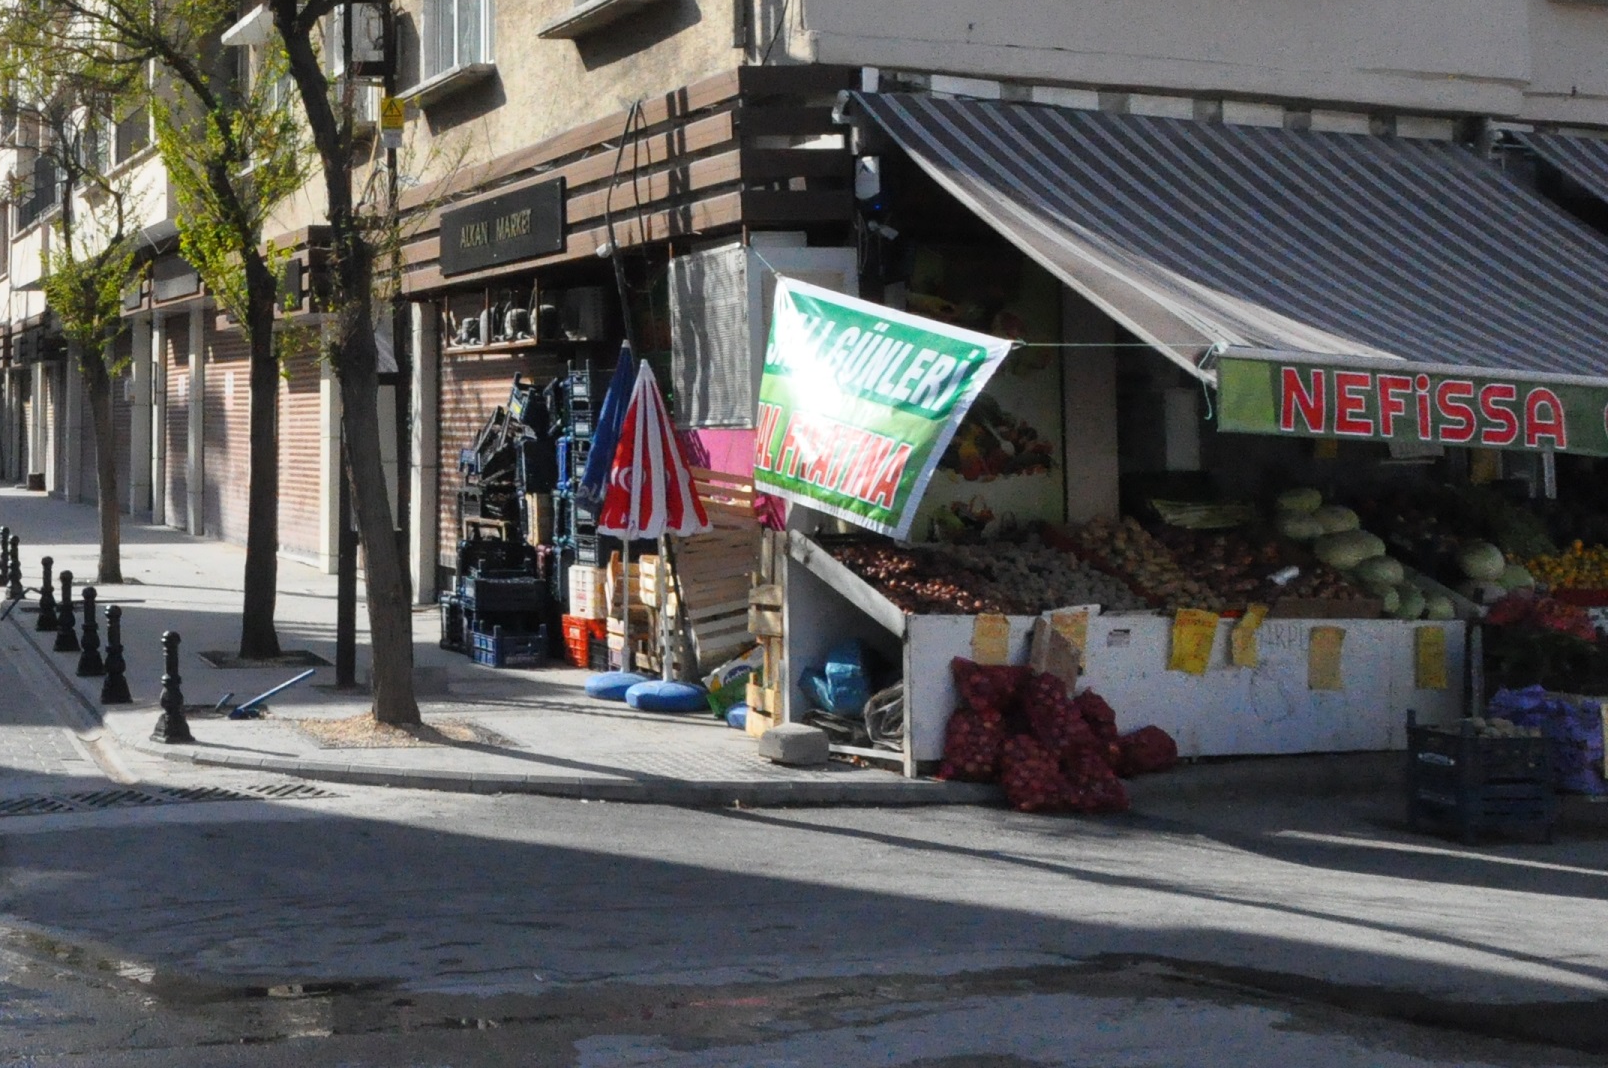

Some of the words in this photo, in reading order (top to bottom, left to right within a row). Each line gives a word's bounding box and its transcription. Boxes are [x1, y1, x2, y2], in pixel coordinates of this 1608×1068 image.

[460, 222, 488, 248] ALKAN
[496, 208, 532, 241] MARKET
[829, 321, 980, 411] GÜNLERİ
